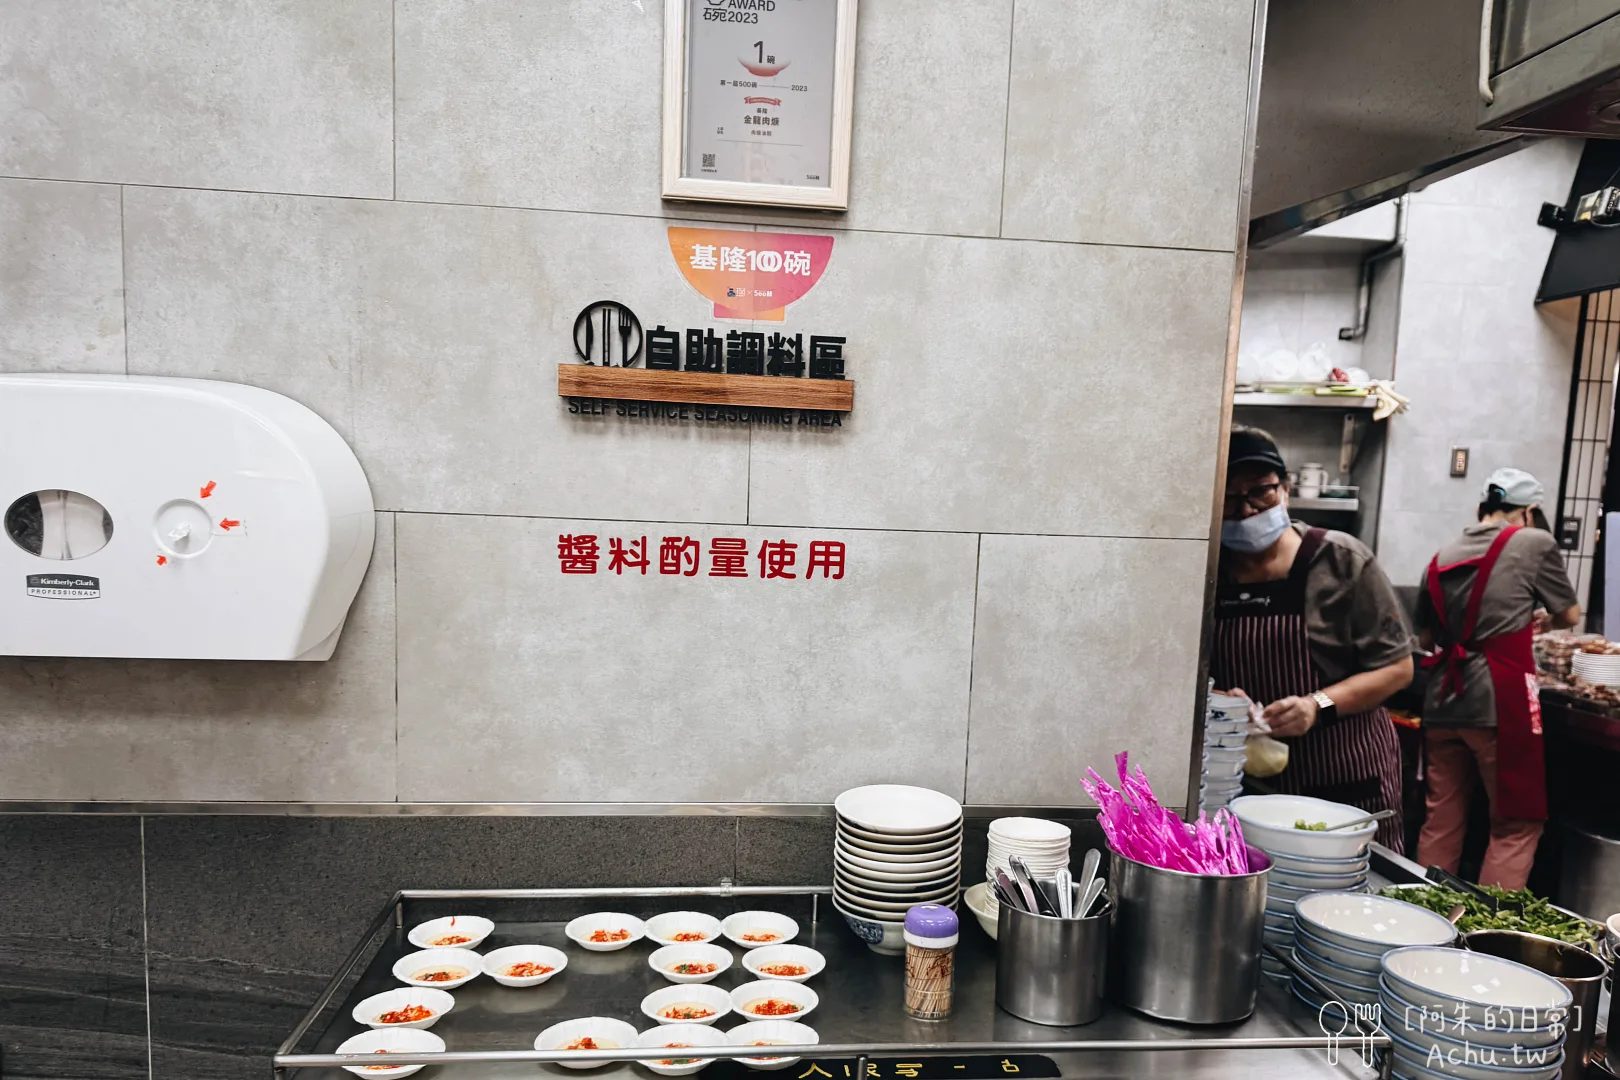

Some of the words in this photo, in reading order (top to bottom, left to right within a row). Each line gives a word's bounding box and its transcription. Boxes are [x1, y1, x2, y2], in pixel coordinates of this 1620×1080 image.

[791, 84, 808, 92] 2023
[689, 243, 811, 277] 基隆100碗
[645, 325, 847, 380] 自助調料區
[568, 397, 610, 415] SELF
[616, 400, 689, 420] SERVICE
[694, 404, 793, 425] SEASONING
[797, 410, 842, 427] AREA
[557, 534, 846, 580] 醬料酌量使用
[40, 578, 94, 587] Kimberly-Clark
